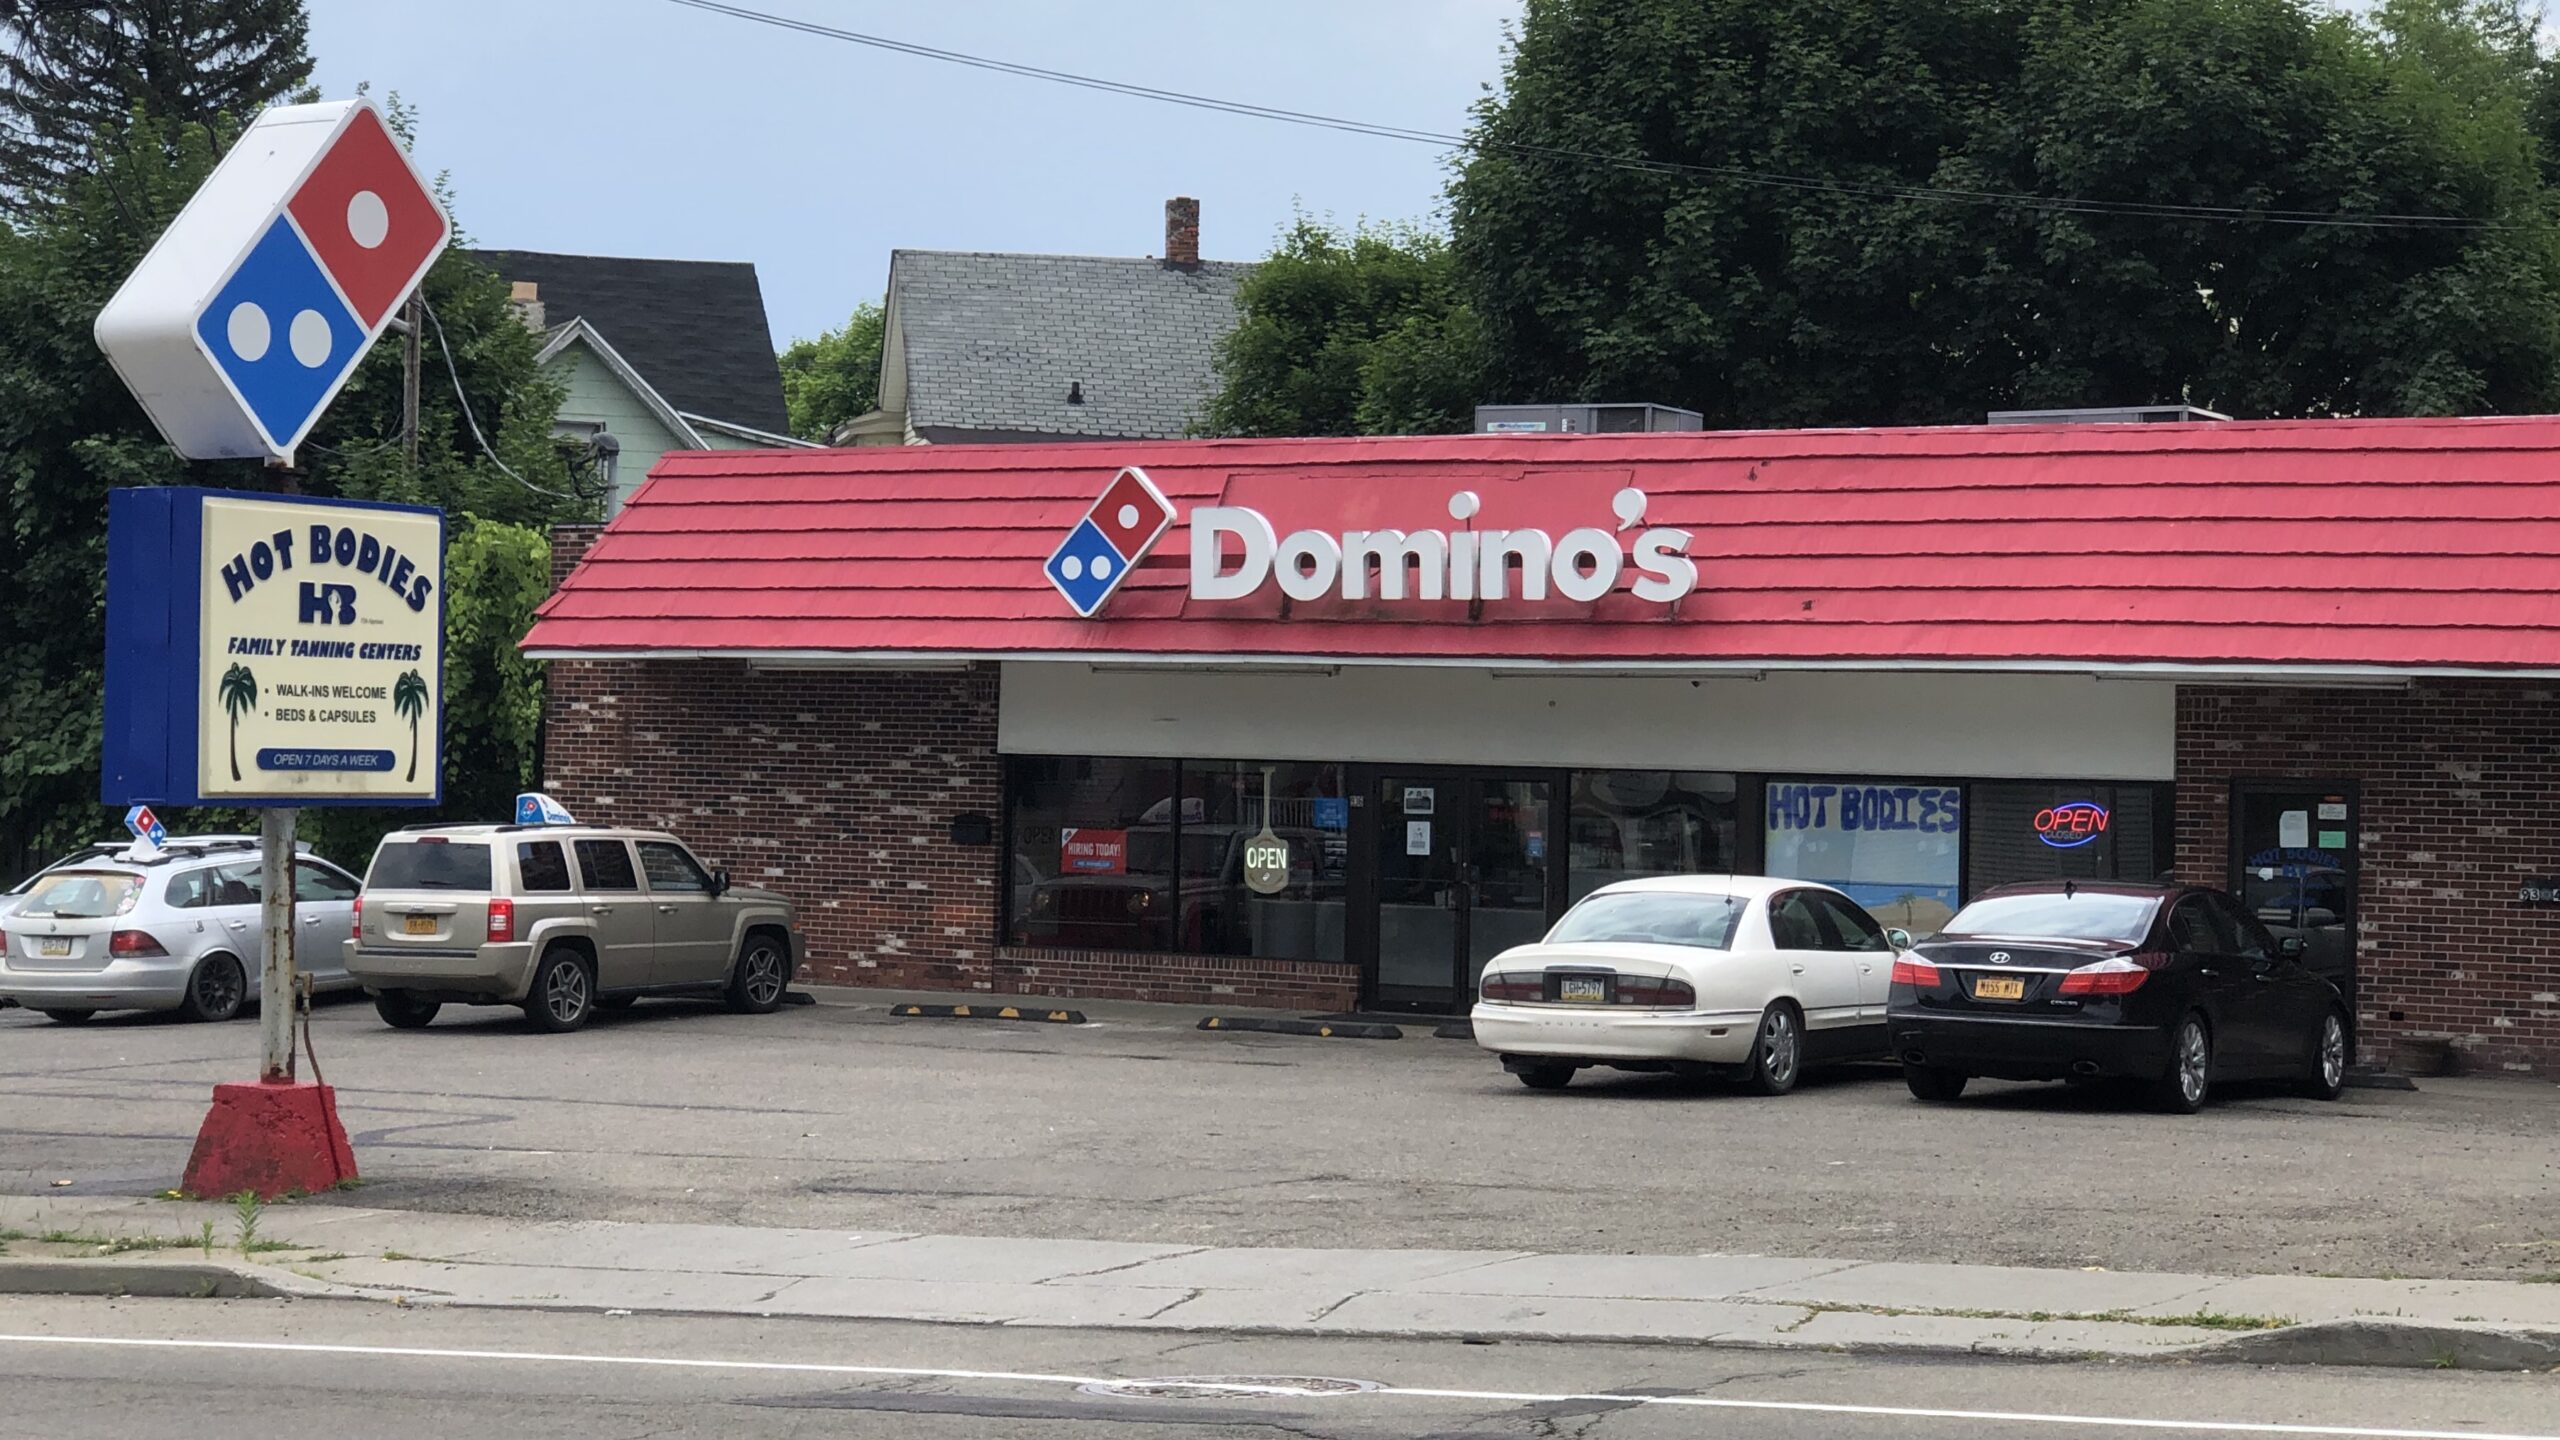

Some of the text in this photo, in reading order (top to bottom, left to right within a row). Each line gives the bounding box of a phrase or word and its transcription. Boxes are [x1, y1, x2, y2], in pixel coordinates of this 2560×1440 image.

[1190, 487, 1698, 602] Domino's
[221, 525, 433, 612] HOT BODIES
[228, 637, 422, 661] FAMILY TANNING CENTERS
[276, 684, 387, 699] WALK-INS WELCOME
[276, 708, 376, 723] BEDS & CAPSULES
[273, 753, 379, 767] OPEN 7 DAYS A WEEK
[1768, 784, 1961, 834] HOT BODIES
[2034, 808, 2110, 832] OPEN
[2044, 830, 2083, 840] CLOSED
[1068, 842, 1121, 857] HIRING TODAY!
[1246, 847, 1287, 869] OPEN
